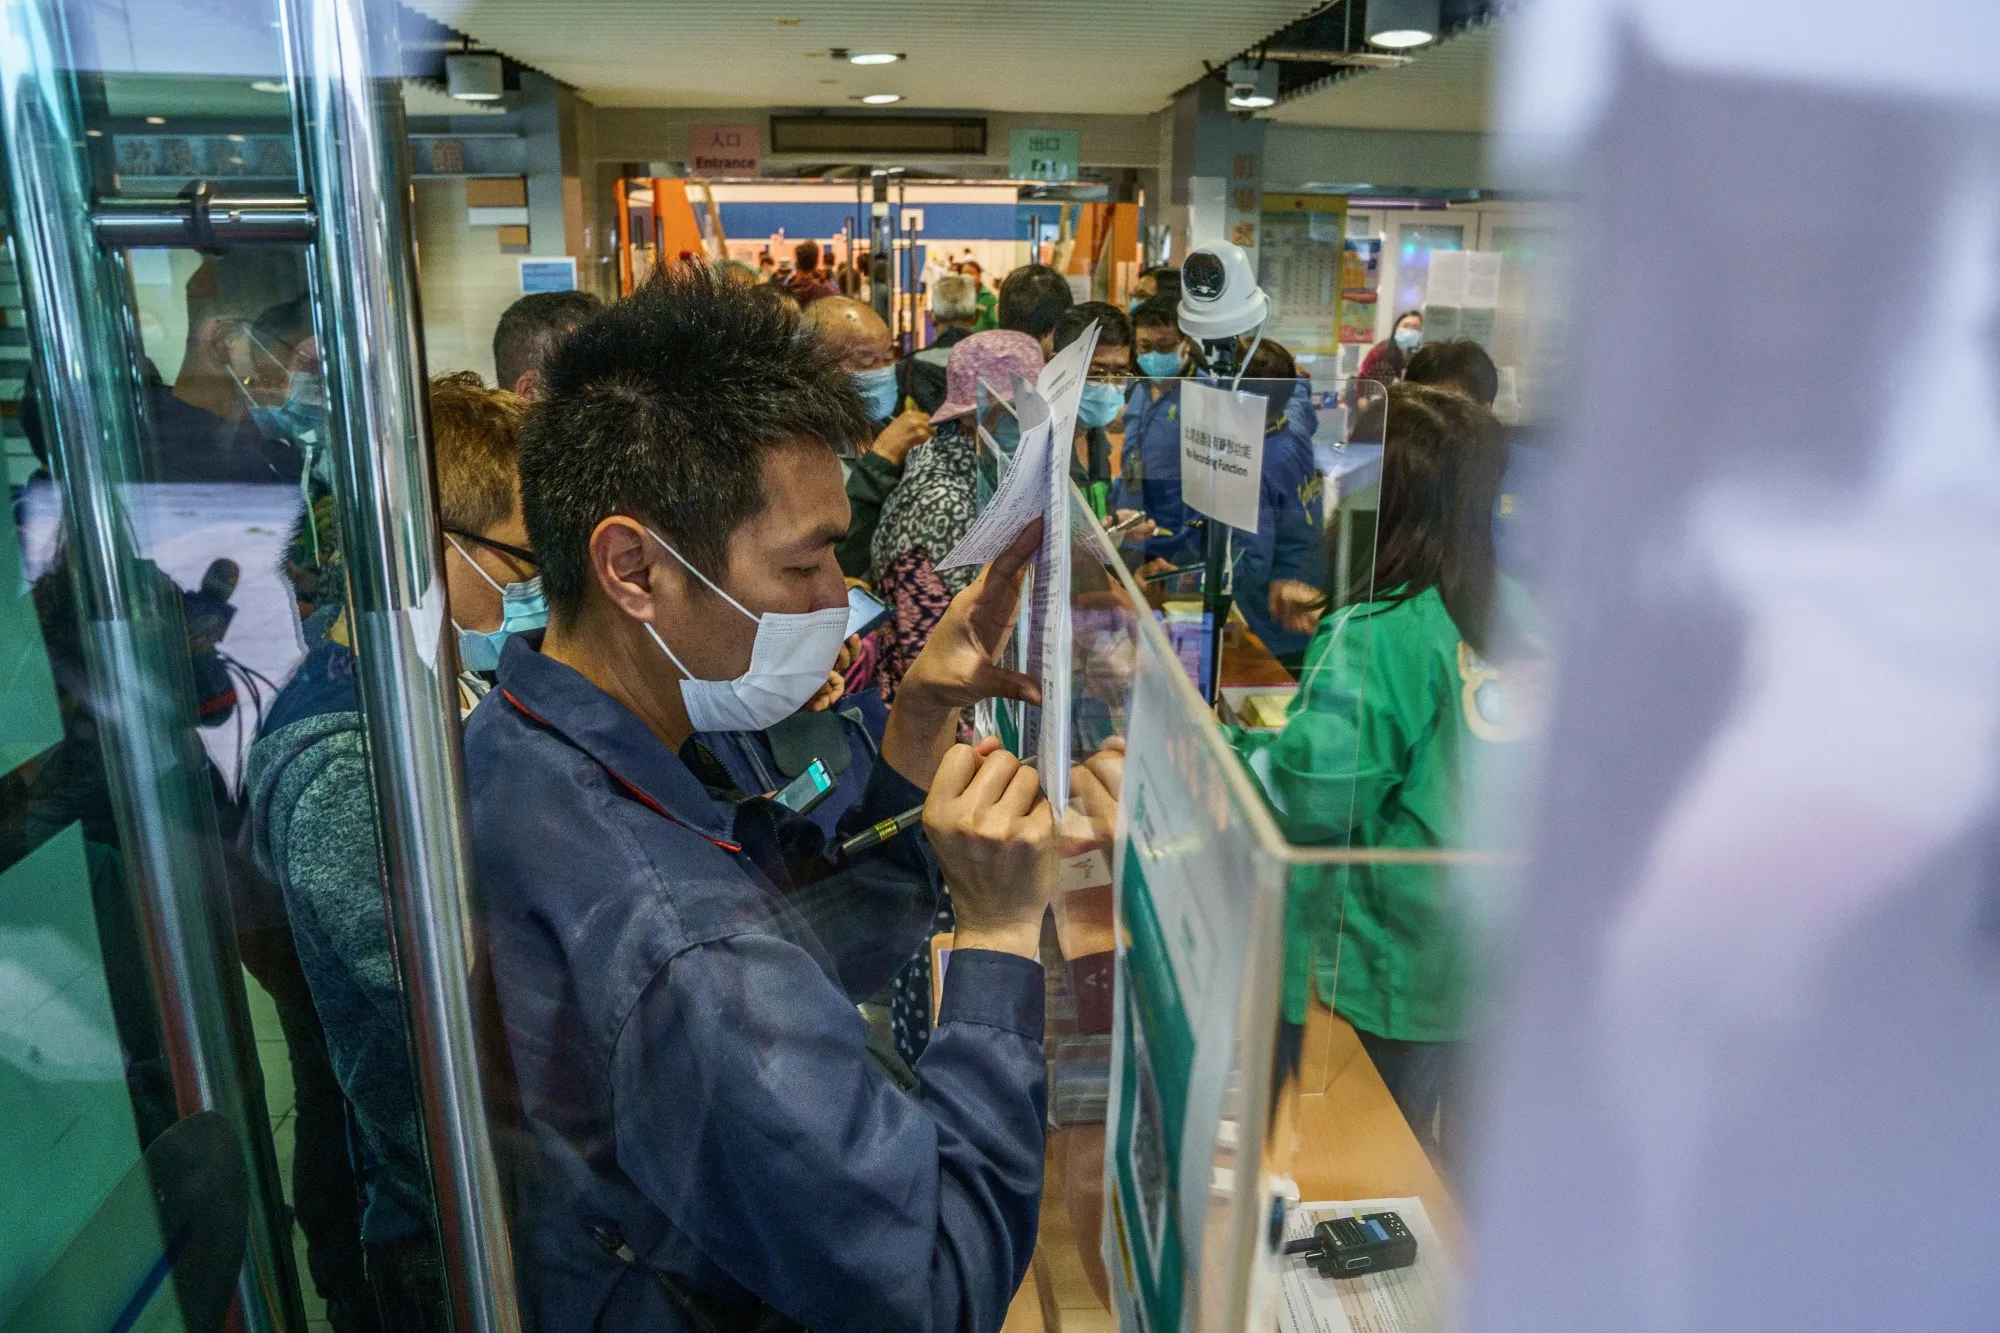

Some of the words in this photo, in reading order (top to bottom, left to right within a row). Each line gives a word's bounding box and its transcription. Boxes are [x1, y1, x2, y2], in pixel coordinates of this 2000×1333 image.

[1029, 135, 1061, 152] 出口
[695, 155, 757, 170] Entrance
[1030, 158, 1057, 174] Ext
[1218, 459, 1248, 477] Function
